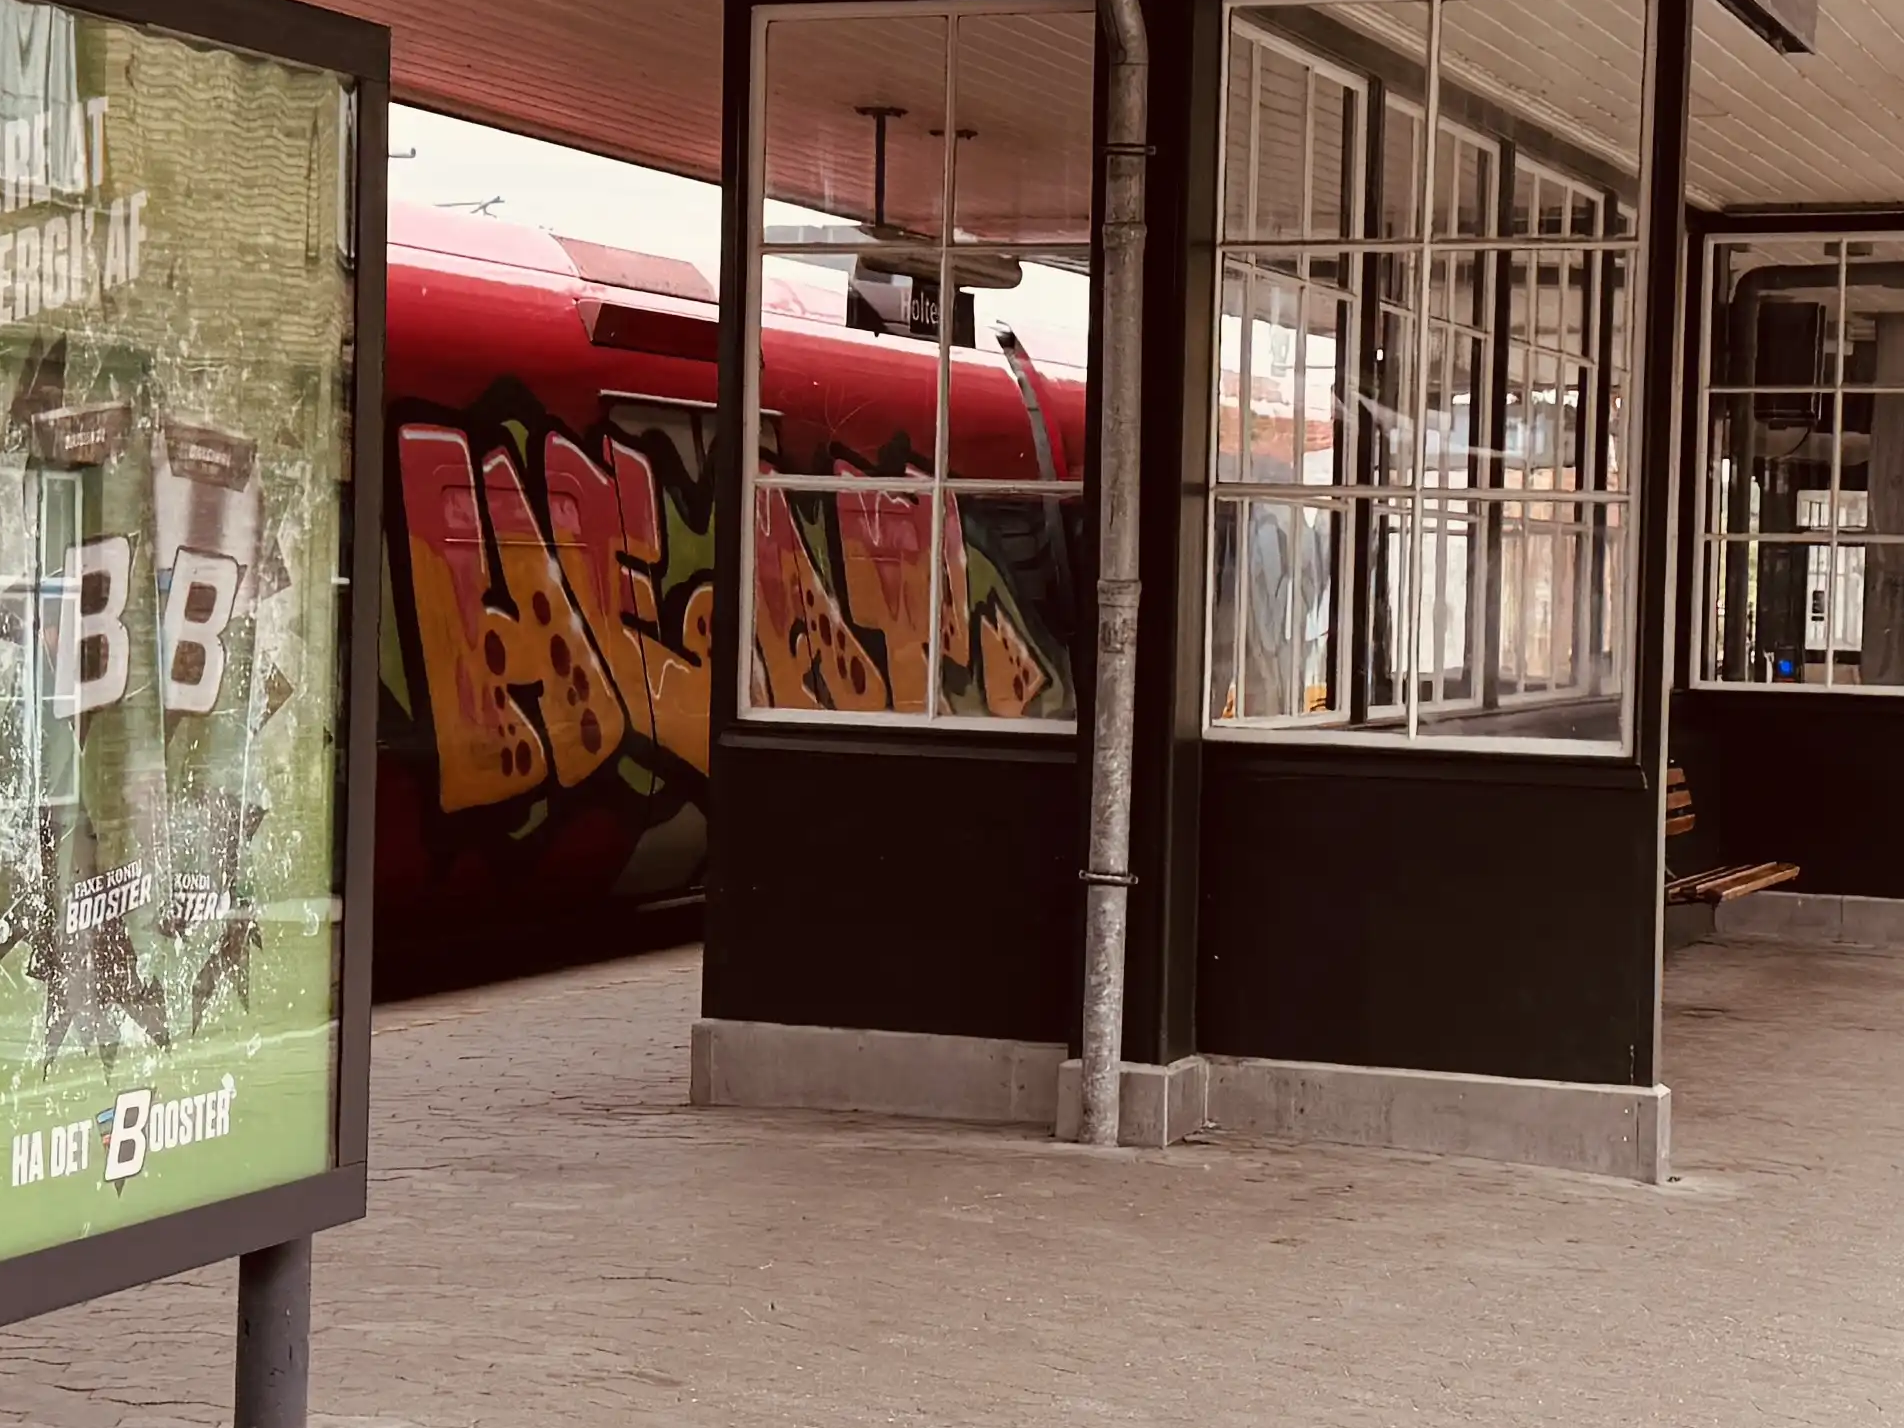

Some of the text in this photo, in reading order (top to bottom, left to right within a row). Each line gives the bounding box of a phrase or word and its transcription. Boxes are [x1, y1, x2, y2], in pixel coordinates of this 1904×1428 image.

[103, 190, 146, 290] AF
[901, 291, 939, 325] Holte
[65, 873, 152, 934] BOOSTER
[74, 859, 142, 900] FAXE KONDI
[11, 1087, 232, 1187] HA DET BOOSTER
